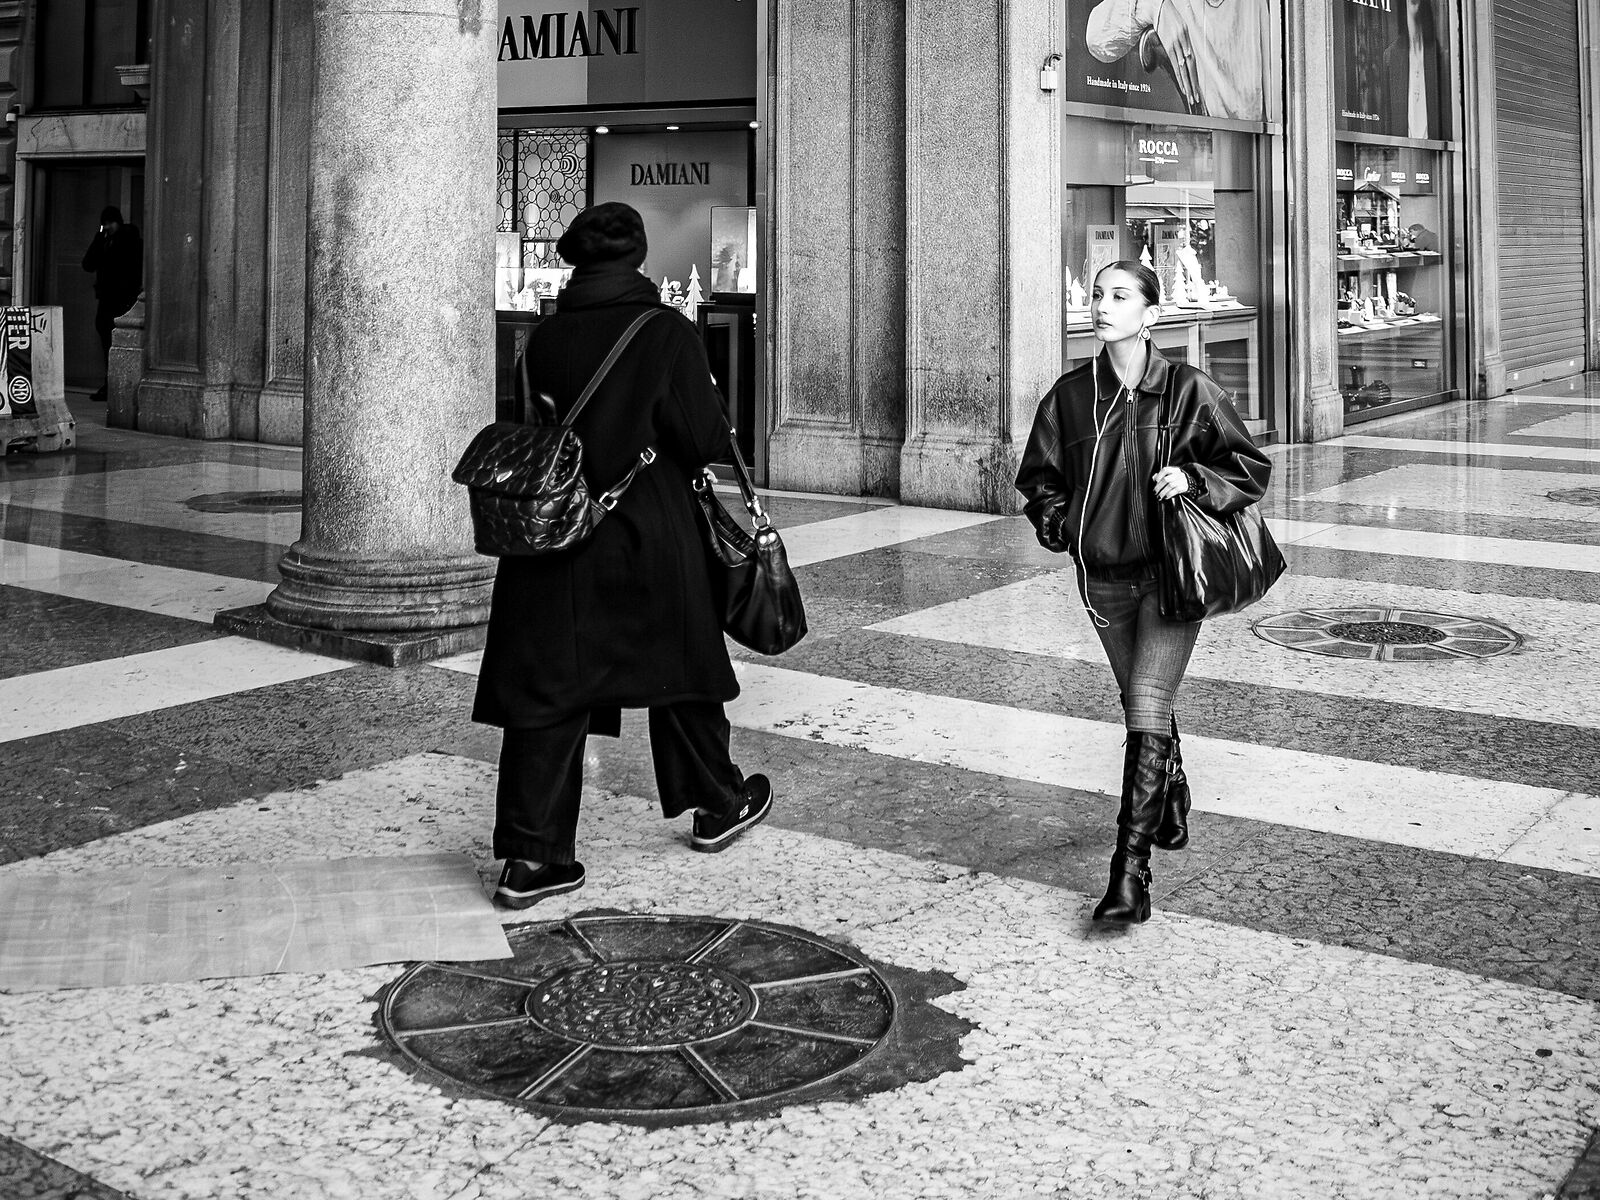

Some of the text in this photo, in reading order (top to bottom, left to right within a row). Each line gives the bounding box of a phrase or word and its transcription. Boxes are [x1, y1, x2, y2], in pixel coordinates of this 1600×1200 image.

[497, 7, 640, 62] AMIANI
[1086, 75, 1112, 88] Handmade
[1118, 79, 1129, 93] Italy
[1129, 82, 1140, 92] since
[1138, 139, 1179, 156] ROCCA
[630, 162, 711, 186] DAMIANI
